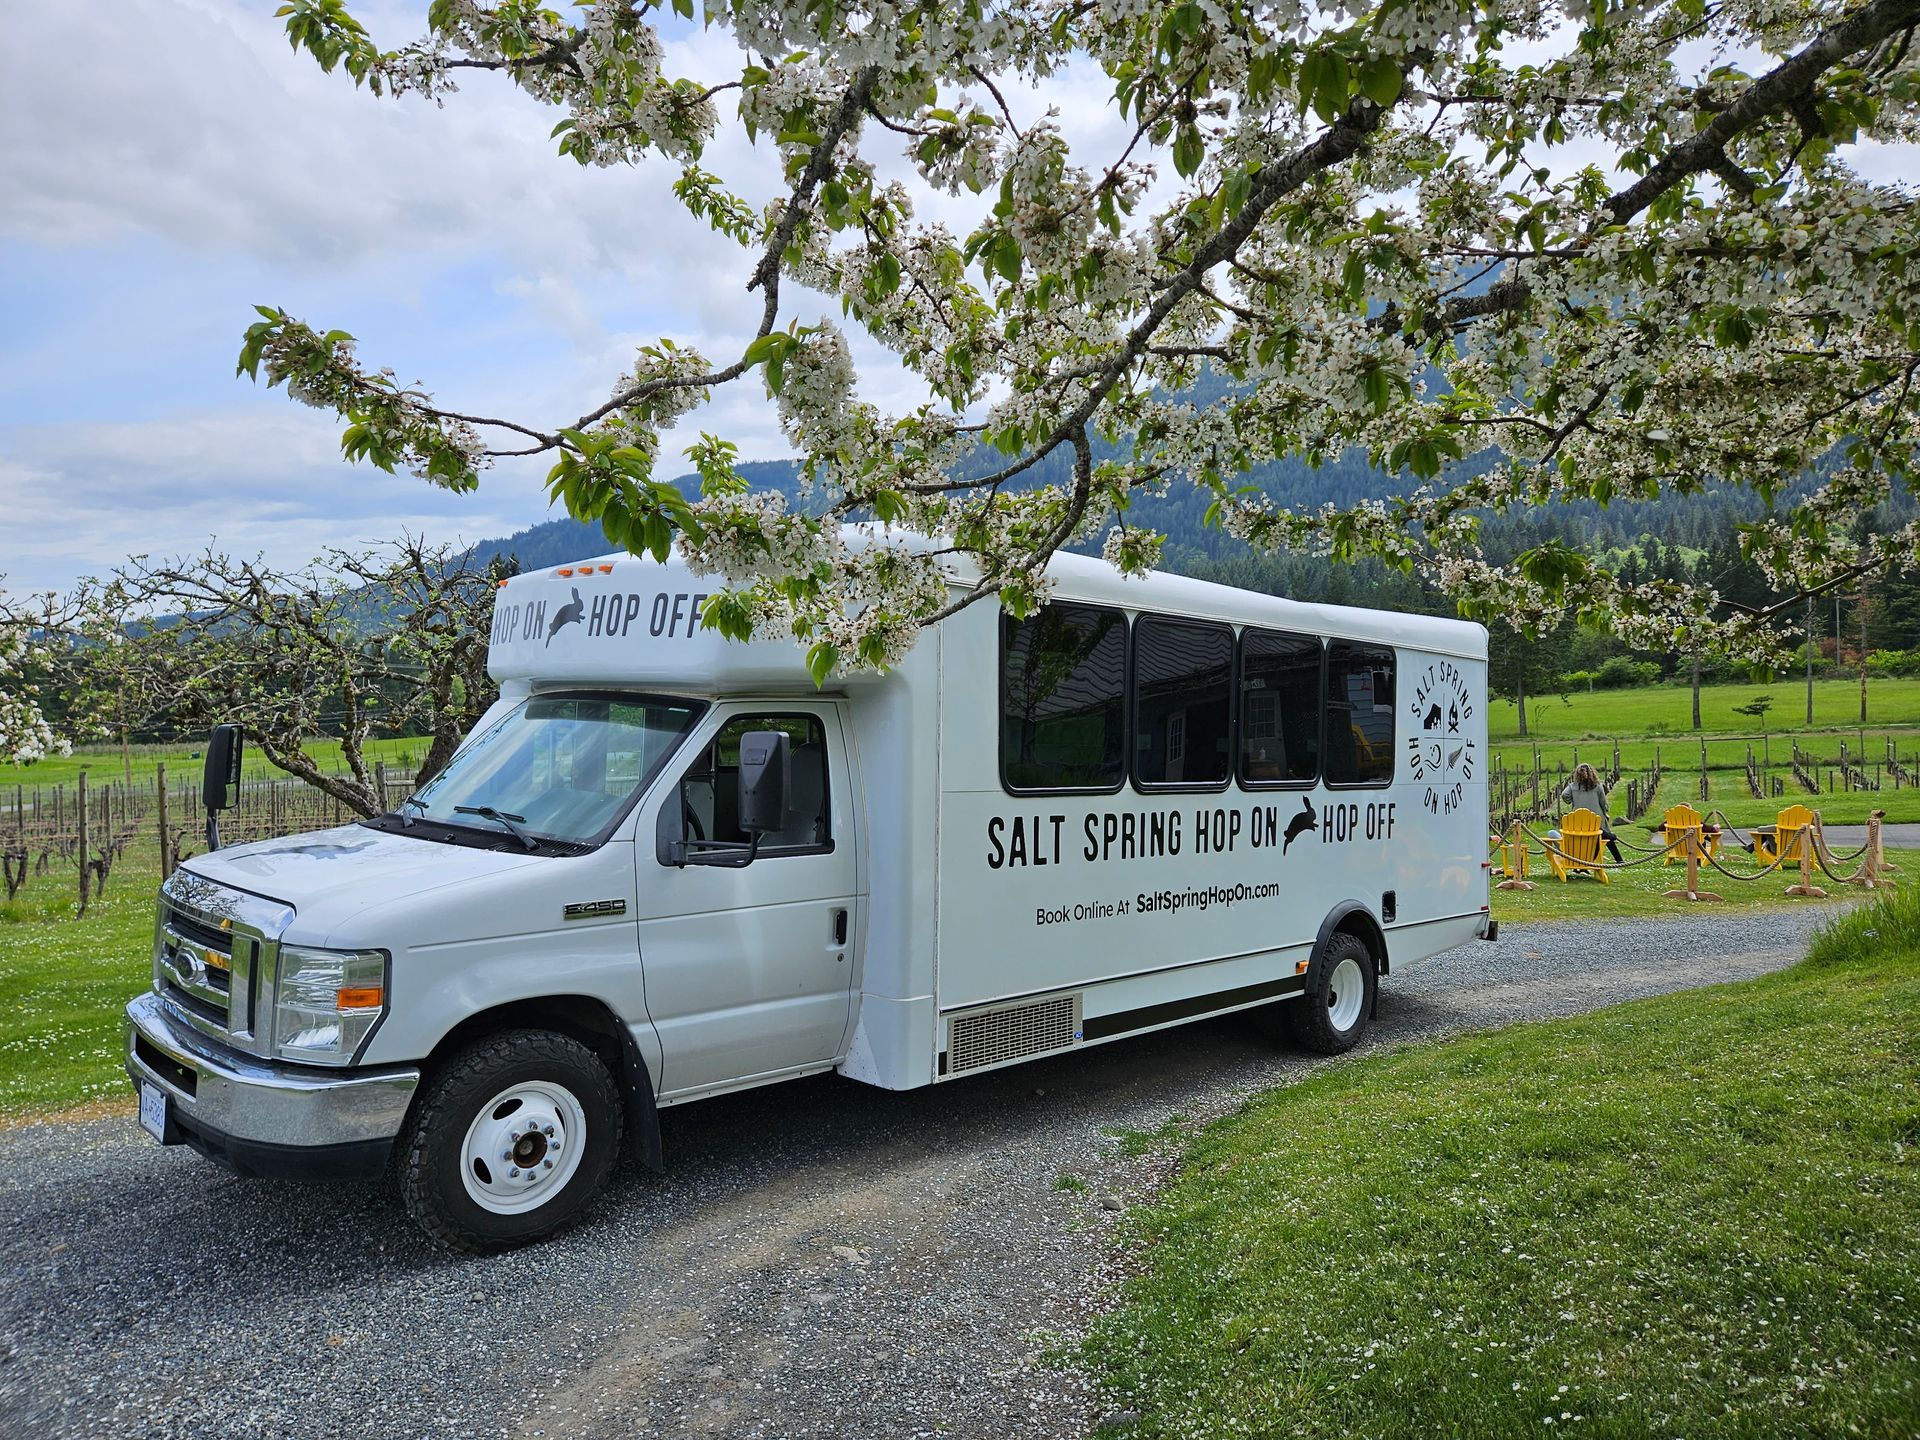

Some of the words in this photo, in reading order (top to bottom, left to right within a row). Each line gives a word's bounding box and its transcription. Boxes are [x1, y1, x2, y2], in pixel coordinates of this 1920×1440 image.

[491, 605, 520, 646] HOP
[522, 600, 547, 641] ON
[587, 593, 641, 637] HOP
[649, 592, 708, 639] OFF
[1411, 665, 1435, 718] SALT
[1440, 660, 1473, 720] SPRING
[1408, 737, 1424, 781] HOP
[1424, 786, 1439, 815] ON
[1444, 782, 1463, 816] HOP
[1462, 738, 1475, 780] OFF
[987, 815, 1066, 869] SALT
[1083, 810, 1181, 862] SPRING
[1195, 808, 1241, 854] HOP
[1250, 806, 1278, 848] ON
[1322, 803, 1359, 843] HOP
[1365, 802, 1396, 840] OFF
[1036, 905, 1071, 926] Book
[1073, 900, 1114, 921] Online
[1116, 899, 1131, 916] At
[1136, 882, 1280, 915] SaltSpringHopOn.com
